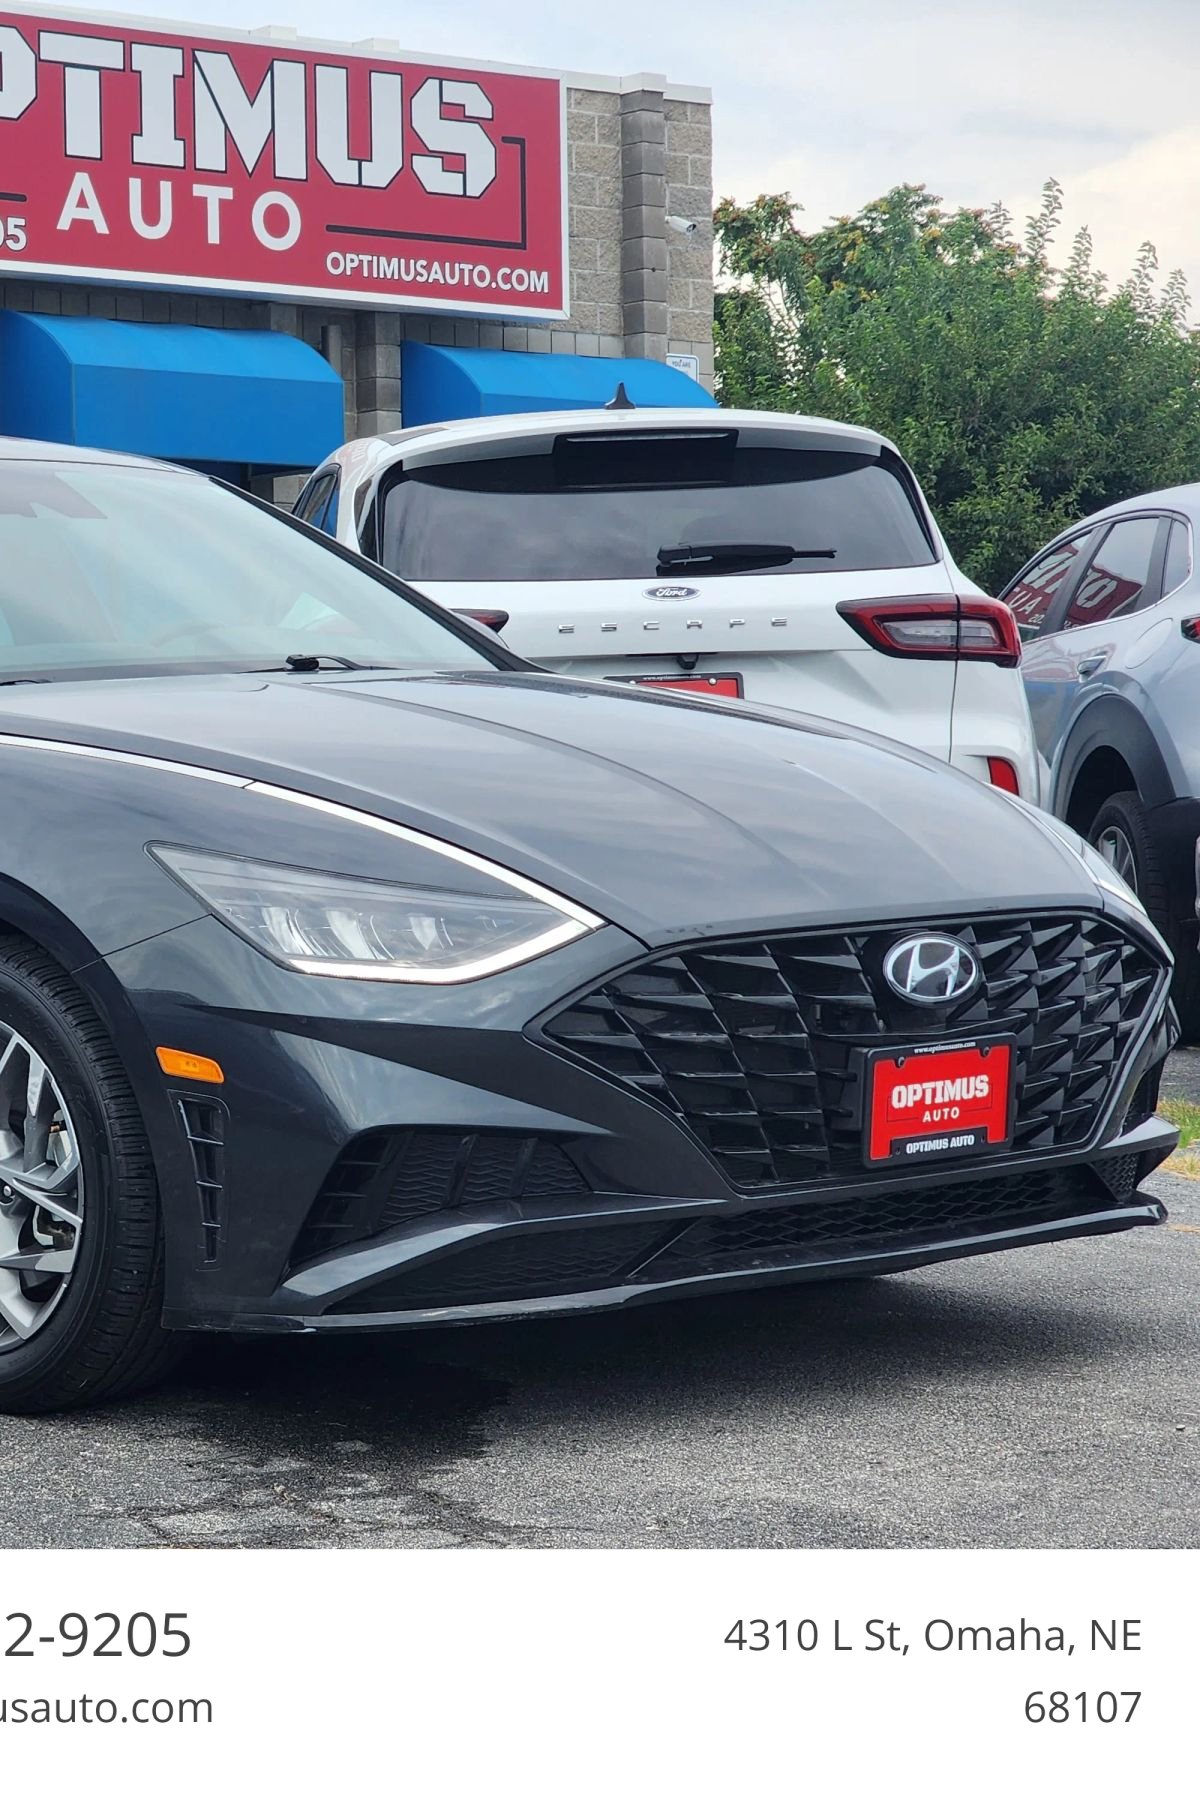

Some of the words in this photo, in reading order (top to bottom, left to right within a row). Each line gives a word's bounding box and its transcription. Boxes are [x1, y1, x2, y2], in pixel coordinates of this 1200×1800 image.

[56, 171, 302, 251] AUTO
[326, 251, 550, 293] OPTIMUSAUTO.COM
[558, 616, 788, 634] ESCAPE
[891, 1074, 989, 1109] OPTIMUS
[922, 1106, 961, 1123] AUTO
[906, 1137, 949, 1154] OPTIMUS
[950, 1134, 975, 1150] AUTO
